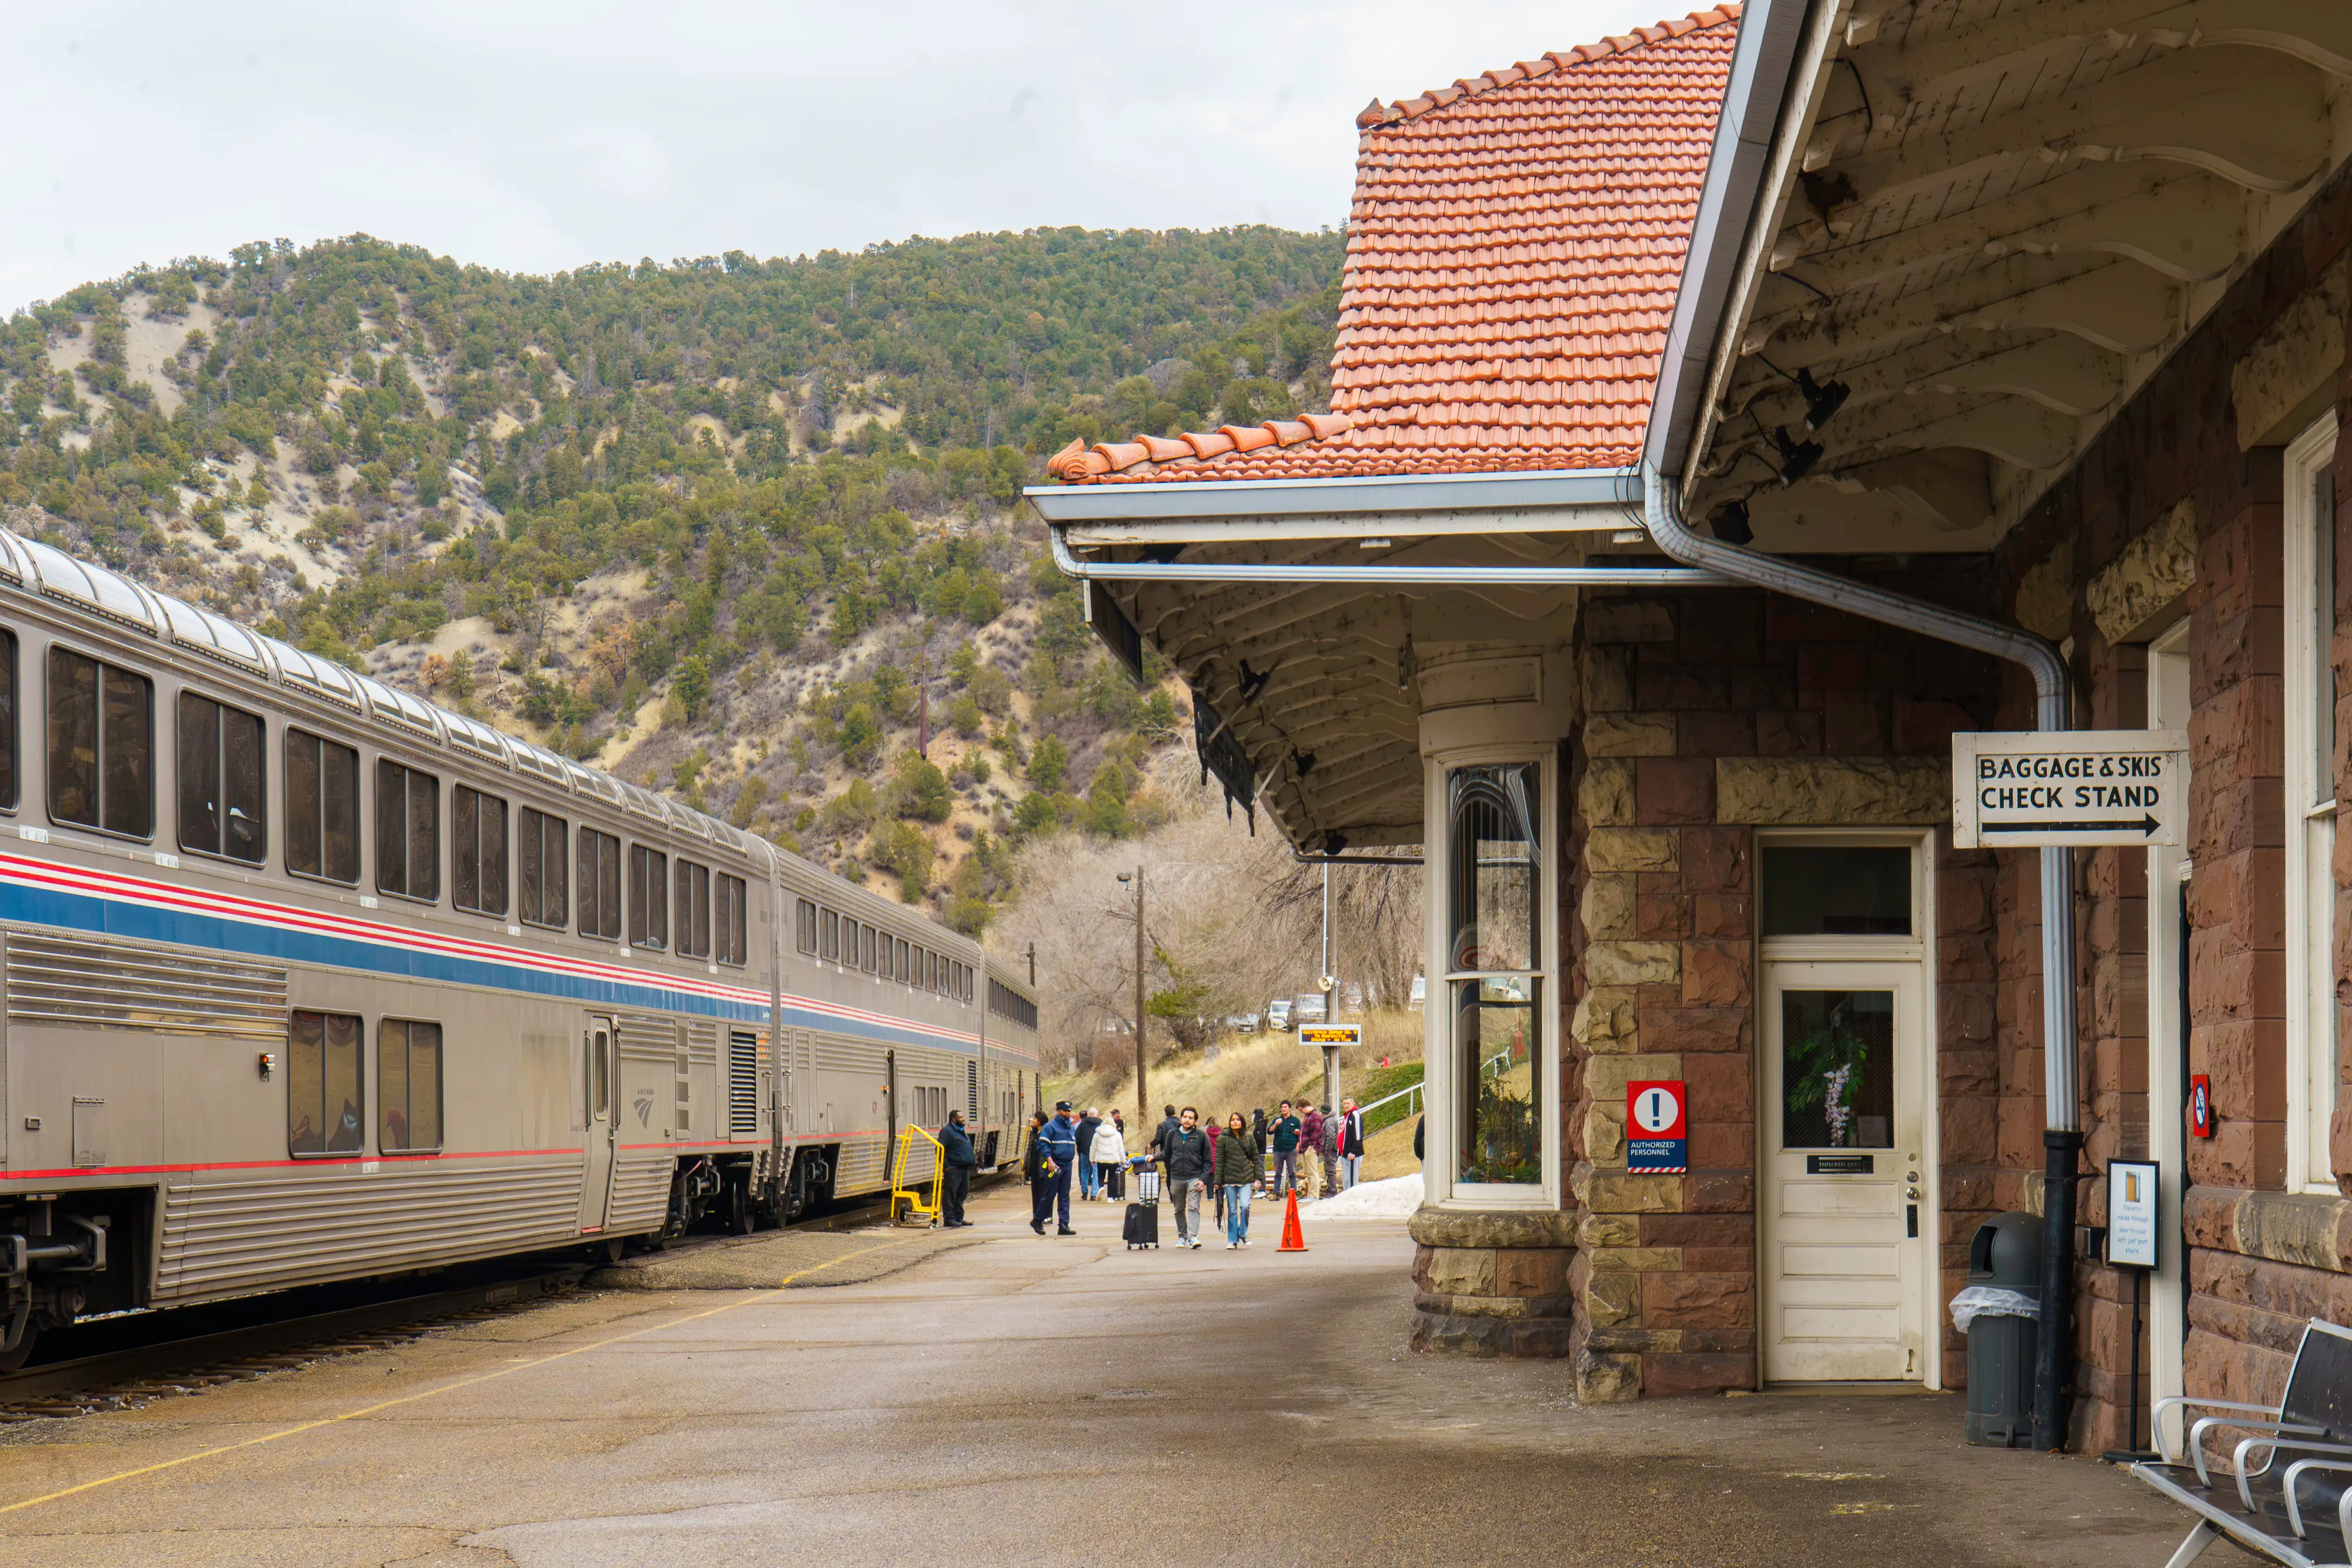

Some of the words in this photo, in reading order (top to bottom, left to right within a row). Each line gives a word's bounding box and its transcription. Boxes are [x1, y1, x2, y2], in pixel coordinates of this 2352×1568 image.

[1980, 757, 2094, 779] BAGGAGE
[2099, 757, 2114, 777] &
[2118, 756, 2161, 777] SKIS
[1981, 787, 2063, 808] CHECK
[2074, 786, 2159, 807] STAND
